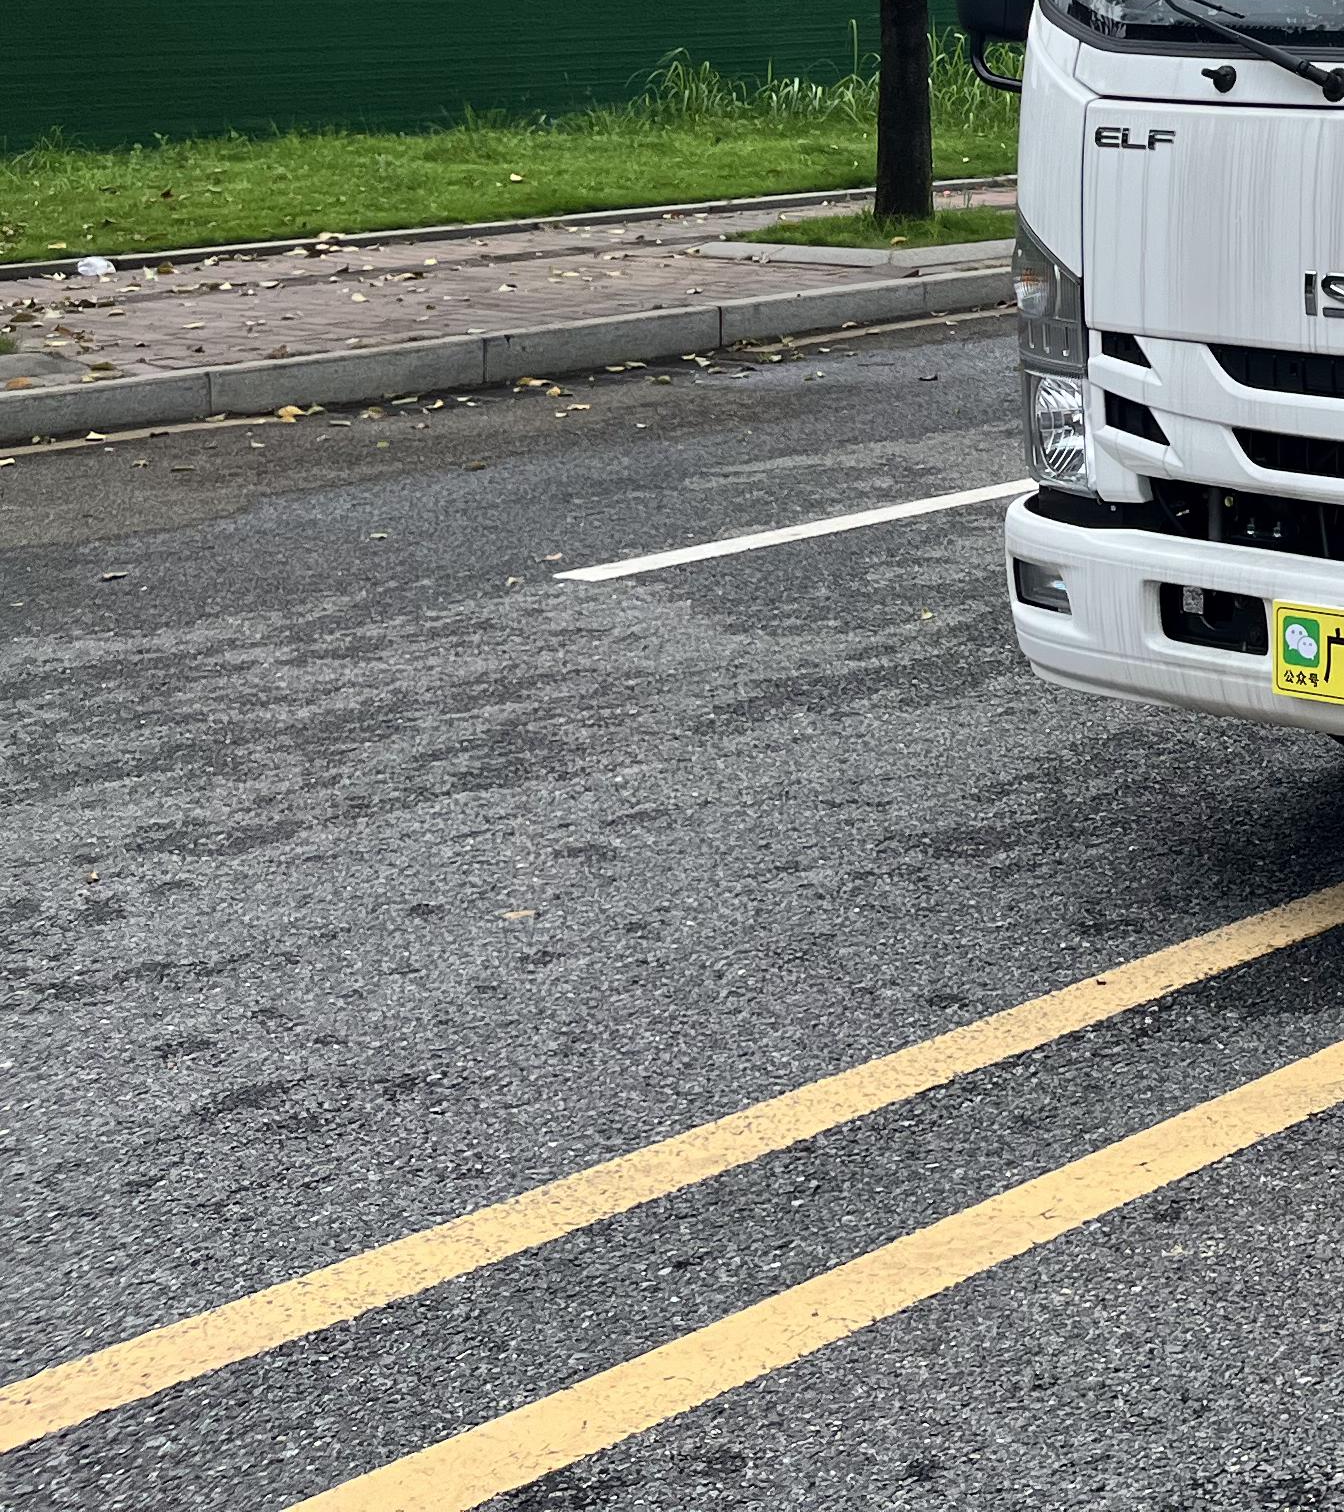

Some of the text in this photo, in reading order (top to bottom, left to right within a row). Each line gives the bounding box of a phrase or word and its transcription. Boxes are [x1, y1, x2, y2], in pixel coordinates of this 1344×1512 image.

[1095, 127, 1176, 150] ELF
[1283, 669, 1320, 687] 公众号
